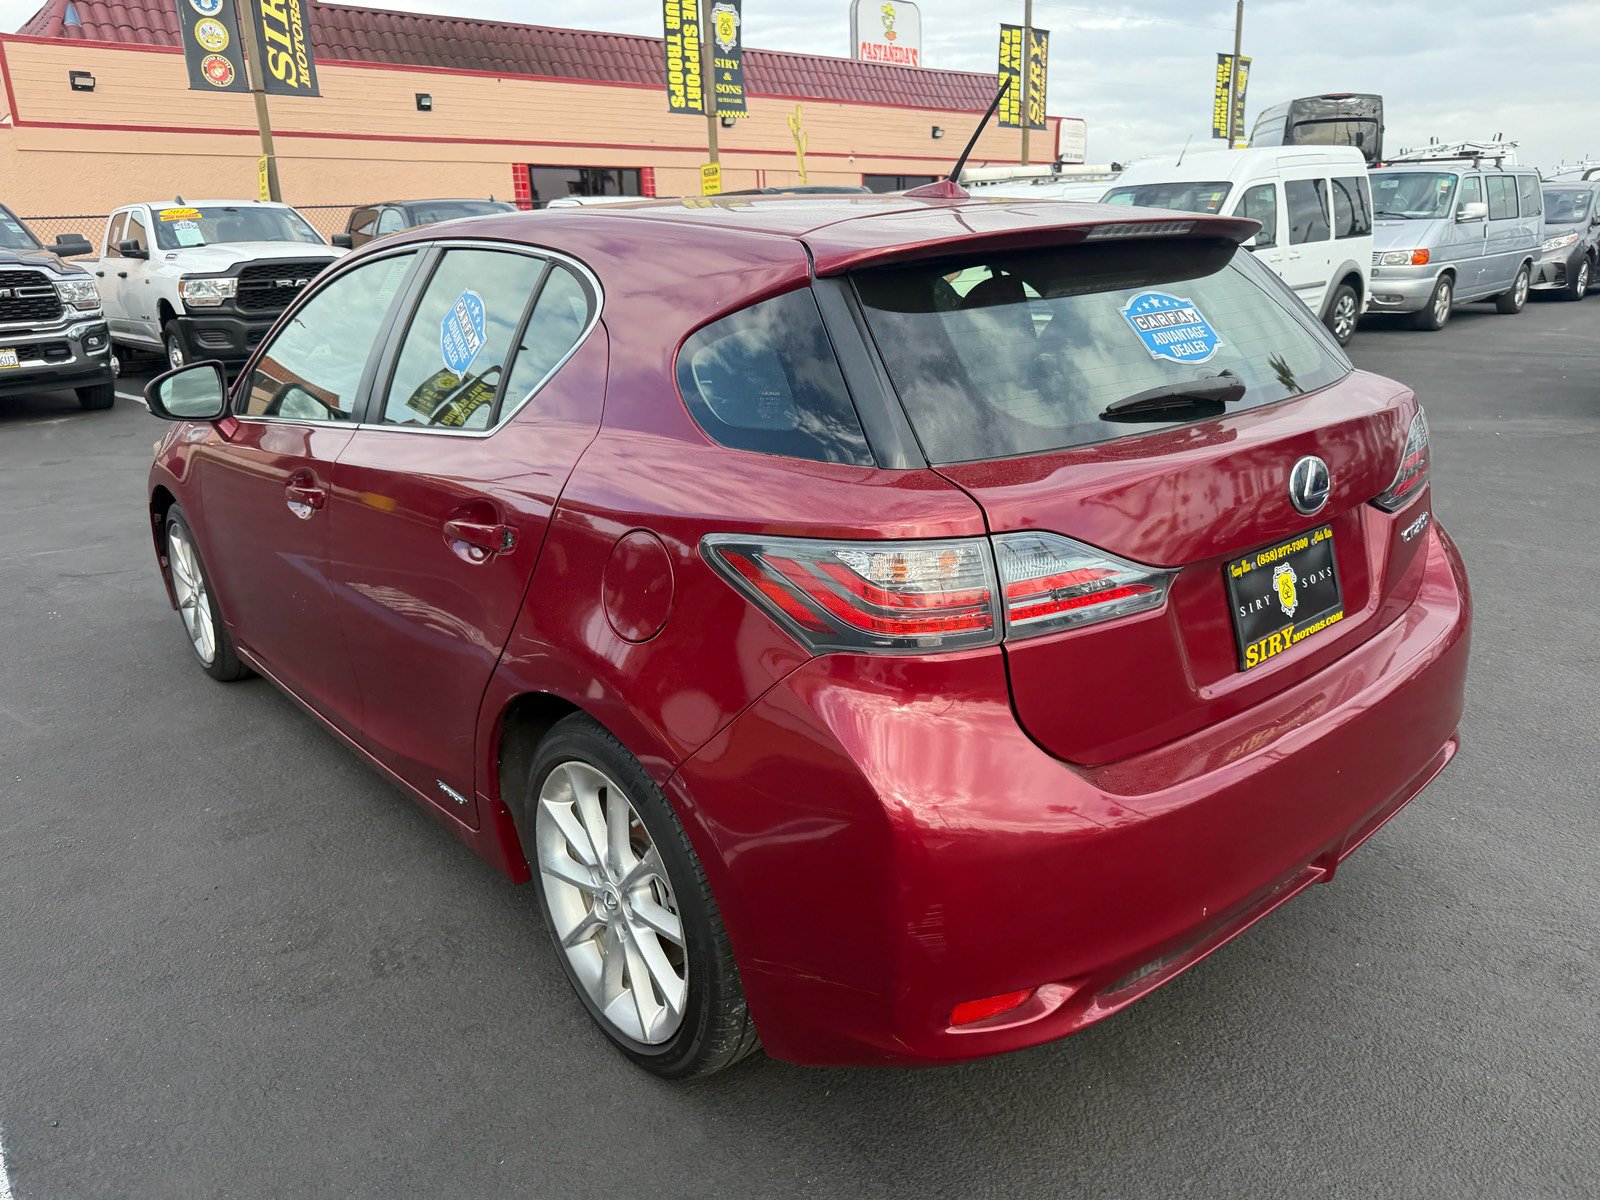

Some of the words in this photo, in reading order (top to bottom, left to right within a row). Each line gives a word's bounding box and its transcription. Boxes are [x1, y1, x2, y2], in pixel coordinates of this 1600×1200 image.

[664, 0, 680, 30] UR
[683, 24, 702, 111] SUPPORT
[714, 58, 739, 70] SIRY
[1000, 30, 1011, 68] PAY
[1011, 29, 1021, 72] BUY
[667, 34, 686, 108] TROOPS
[716, 83, 742, 95] SONS
[723, 72, 732, 81] &
[1029, 31, 1041, 125] SIRY
[1010, 75, 1020, 125] HERE
[455, 299, 479, 353] CARFAX
[1133, 310, 1200, 329] CARFAX
[1152, 326, 1208, 345] ADVANTAGE
[443, 334, 459, 367] DEALER
[448, 317, 469, 362] ADVANTAGE
[1170, 341, 1209, 357] DEALER
[1240, 594, 1270, 617] SIRY
[1302, 567, 1332, 588] SONS
